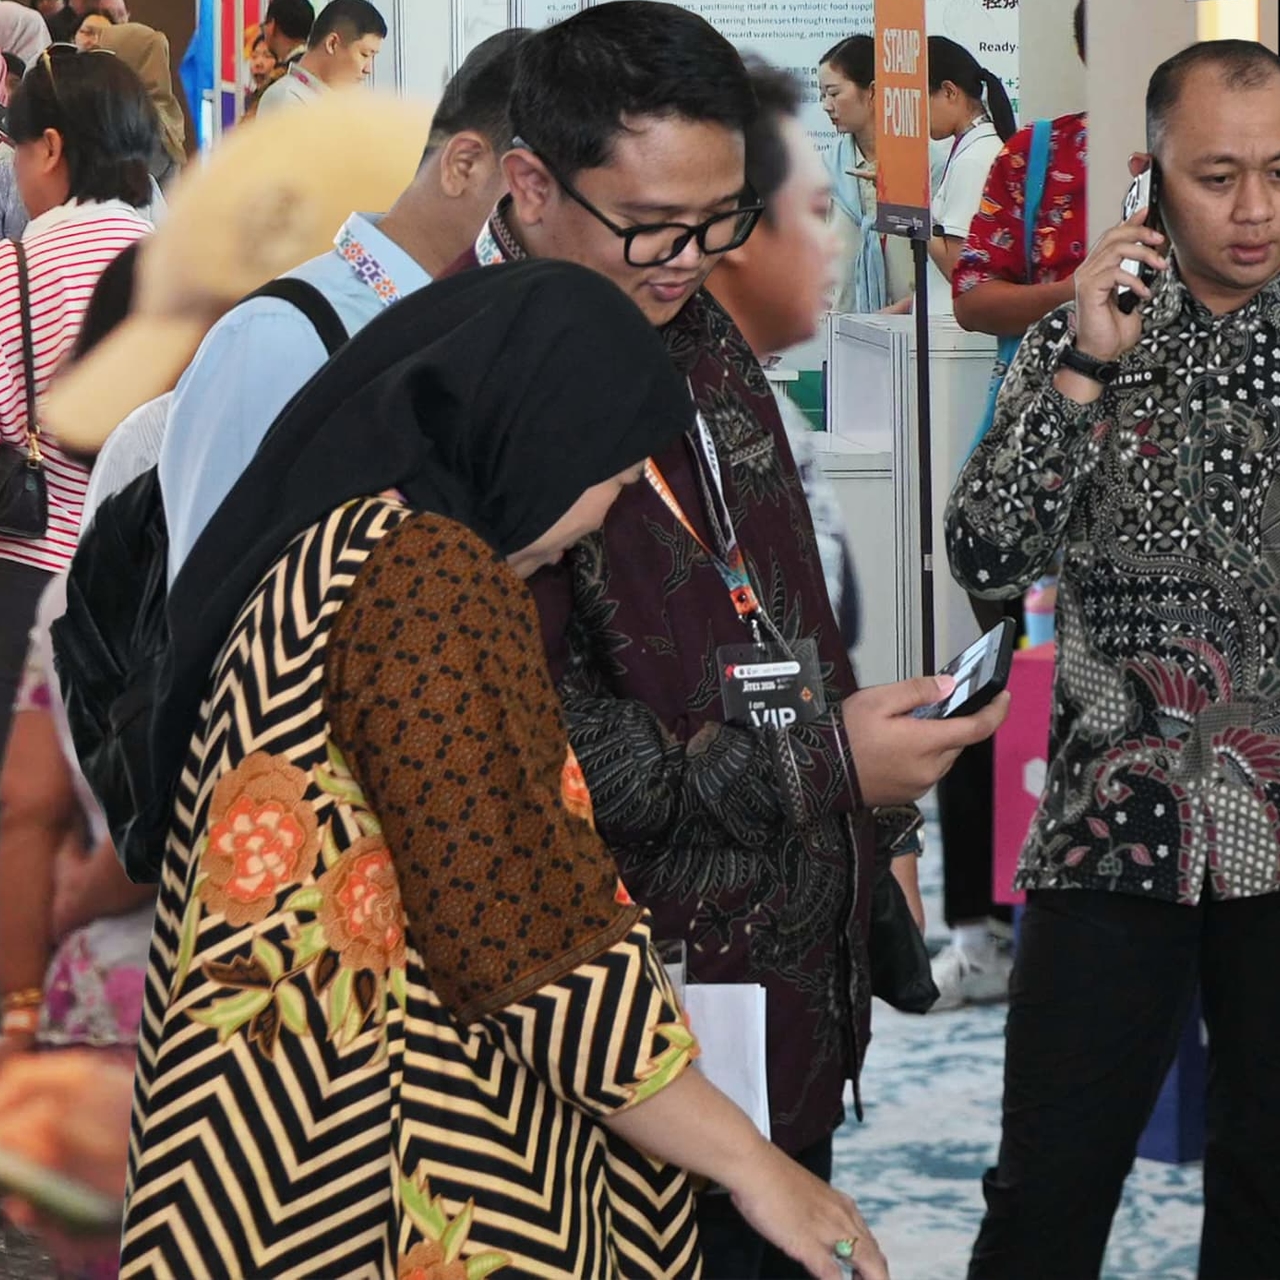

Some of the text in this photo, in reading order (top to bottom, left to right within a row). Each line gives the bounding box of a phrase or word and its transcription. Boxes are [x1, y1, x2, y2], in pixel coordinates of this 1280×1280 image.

[700, 2, 745, 13] positioning
[747, 2, 767, 11] itself
[788, 2, 827, 13] symbiotic
[830, 2, 849, 11] food
[713, 16, 859, 27] catering businesses through trending
[808, 29, 824, 38] and
[883, 28, 920, 75] STAMP
[884, 87, 921, 138] POINT
[1109, 371, 1152, 386] IDHO
[750, 707, 796, 730] VIP
